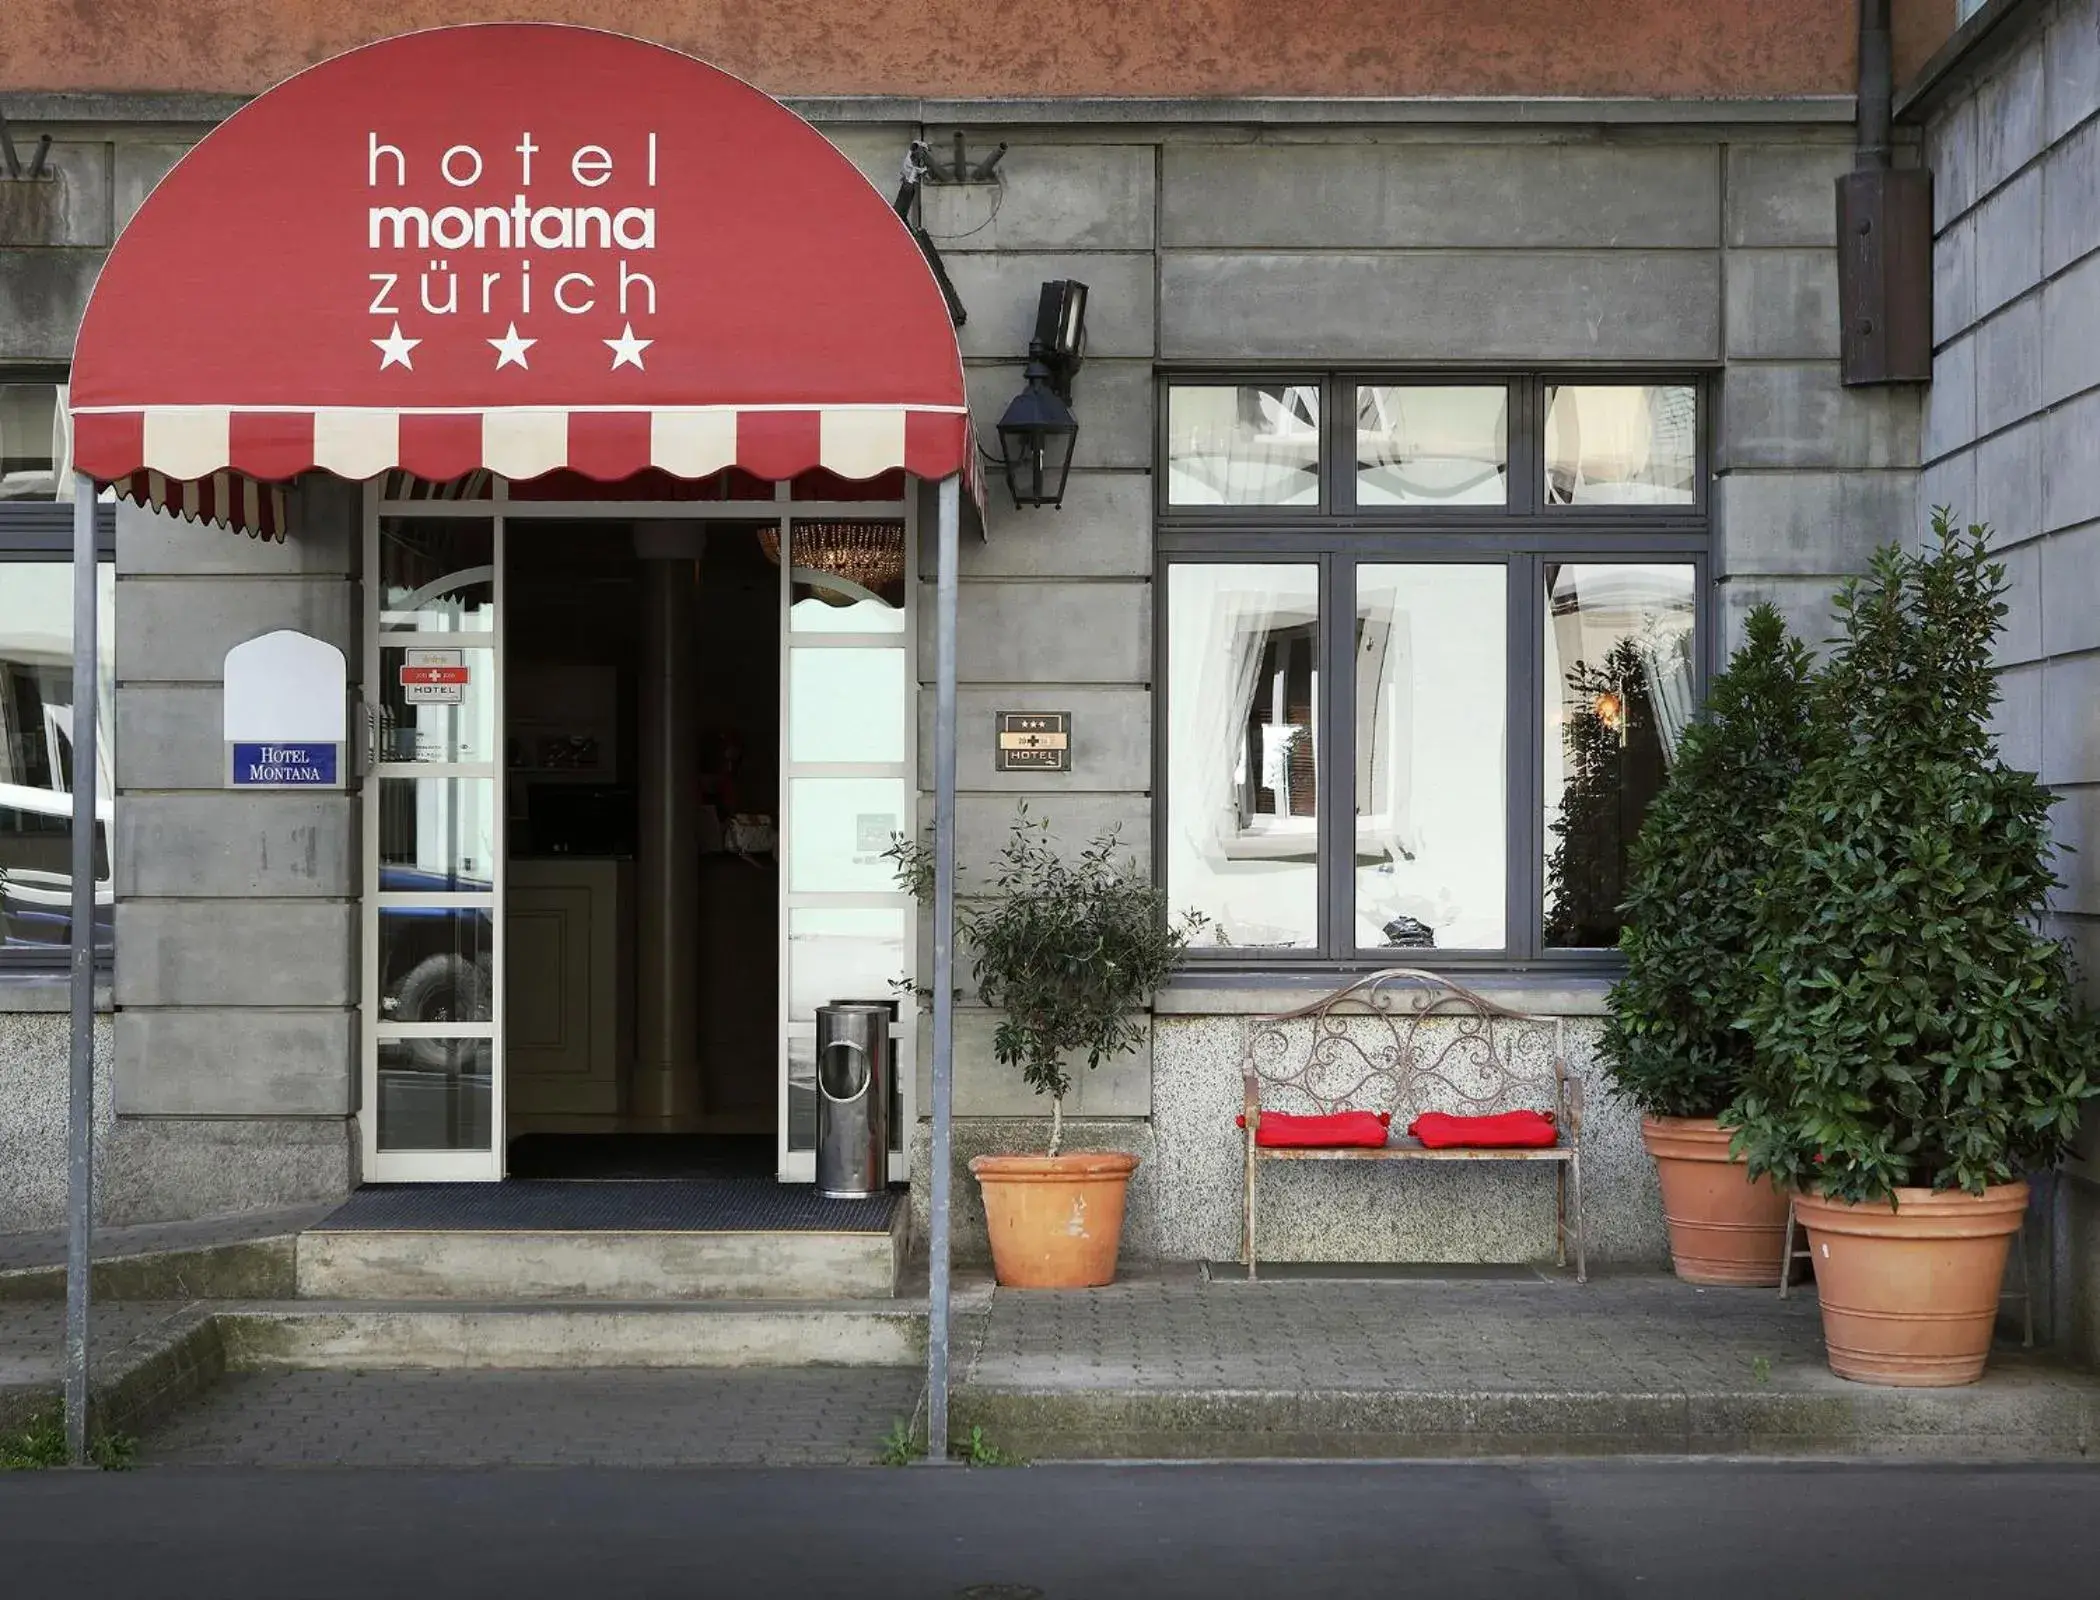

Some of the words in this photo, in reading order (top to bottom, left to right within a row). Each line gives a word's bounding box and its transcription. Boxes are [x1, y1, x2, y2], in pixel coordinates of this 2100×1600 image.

[369, 132, 656, 187] hotel
[369, 194, 656, 249] montana
[369, 260, 656, 314] zürich
[414, 686, 456, 694] HOTEL
[260, 747, 310, 763] HOTEL
[1011, 751, 1056, 760] HOTEL
[250, 765, 321, 781] MONTANA
